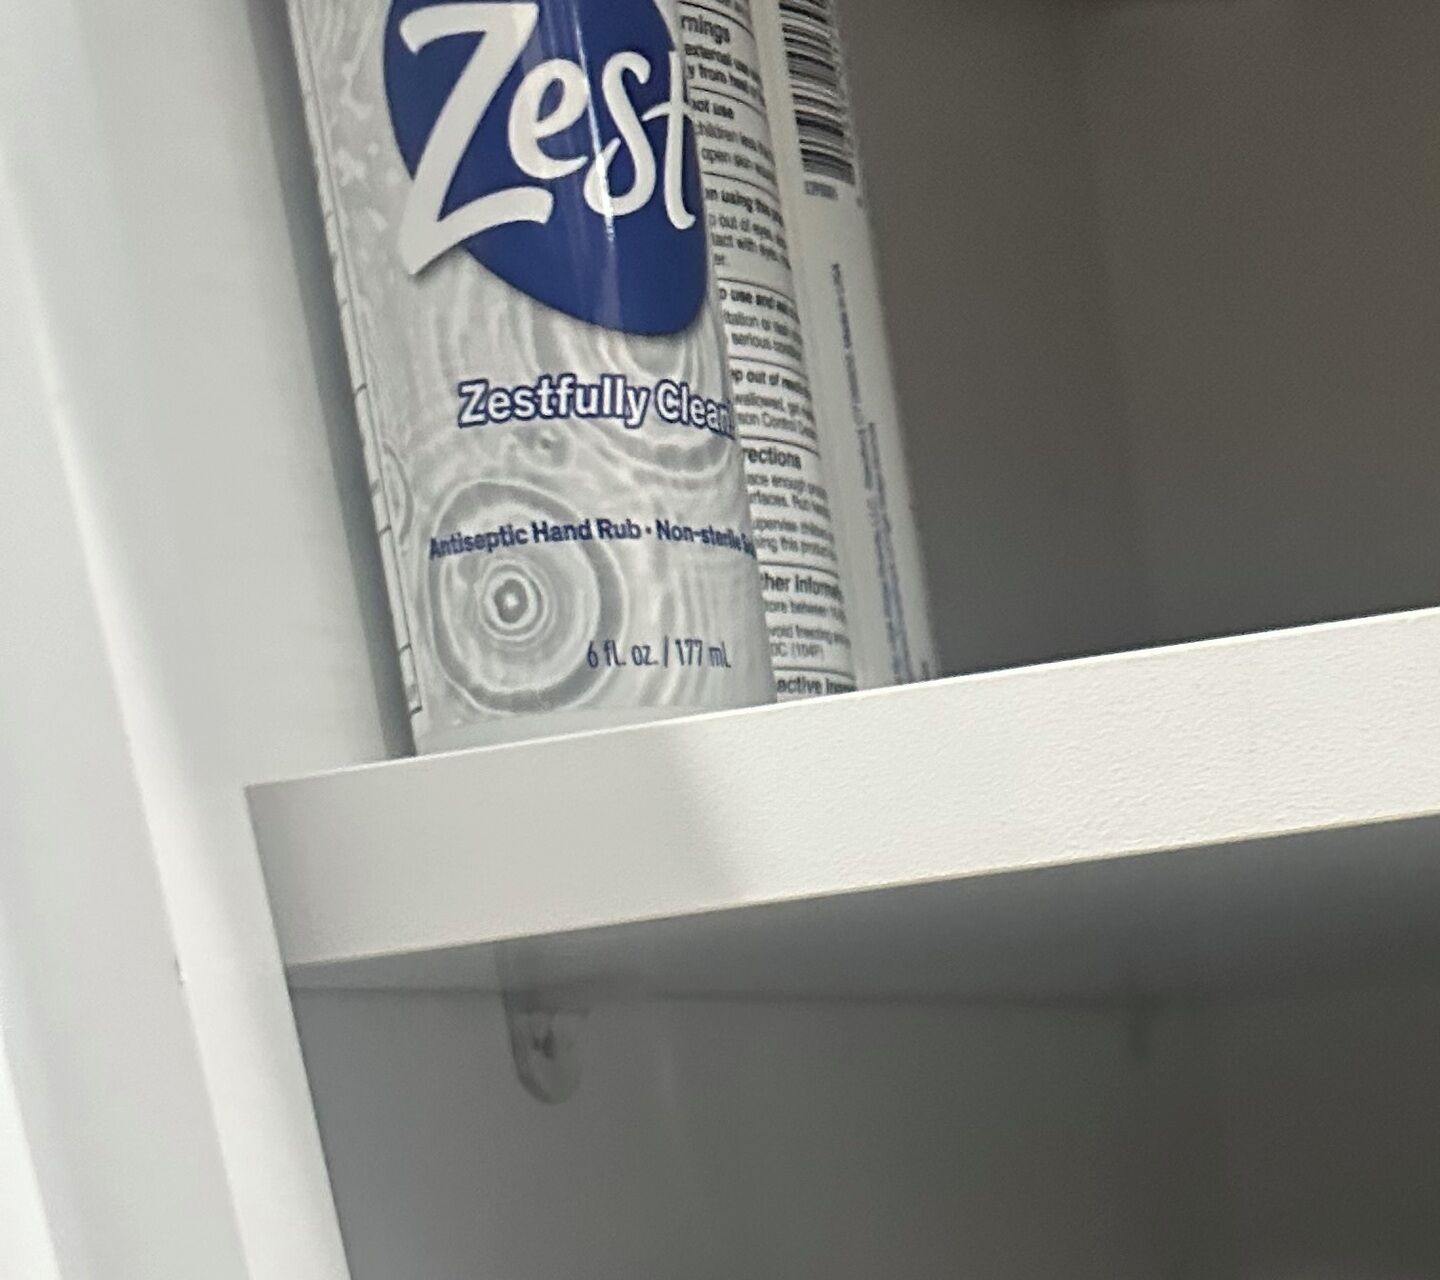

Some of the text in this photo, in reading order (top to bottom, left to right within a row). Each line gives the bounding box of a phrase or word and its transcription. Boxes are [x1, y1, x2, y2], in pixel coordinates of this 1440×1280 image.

[680, 14, 731, 45] rnings
[398, 2, 697, 276] Zest
[458, 373, 648, 429] Zestfully
[743, 446, 803, 470] rections
[430, 523, 529, 560] Antiseptic
[531, 517, 593, 543] Hand
[596, 518, 642, 540] Rub
[587, 641, 599, 668] 6
[675, 638, 703, 667] 177
